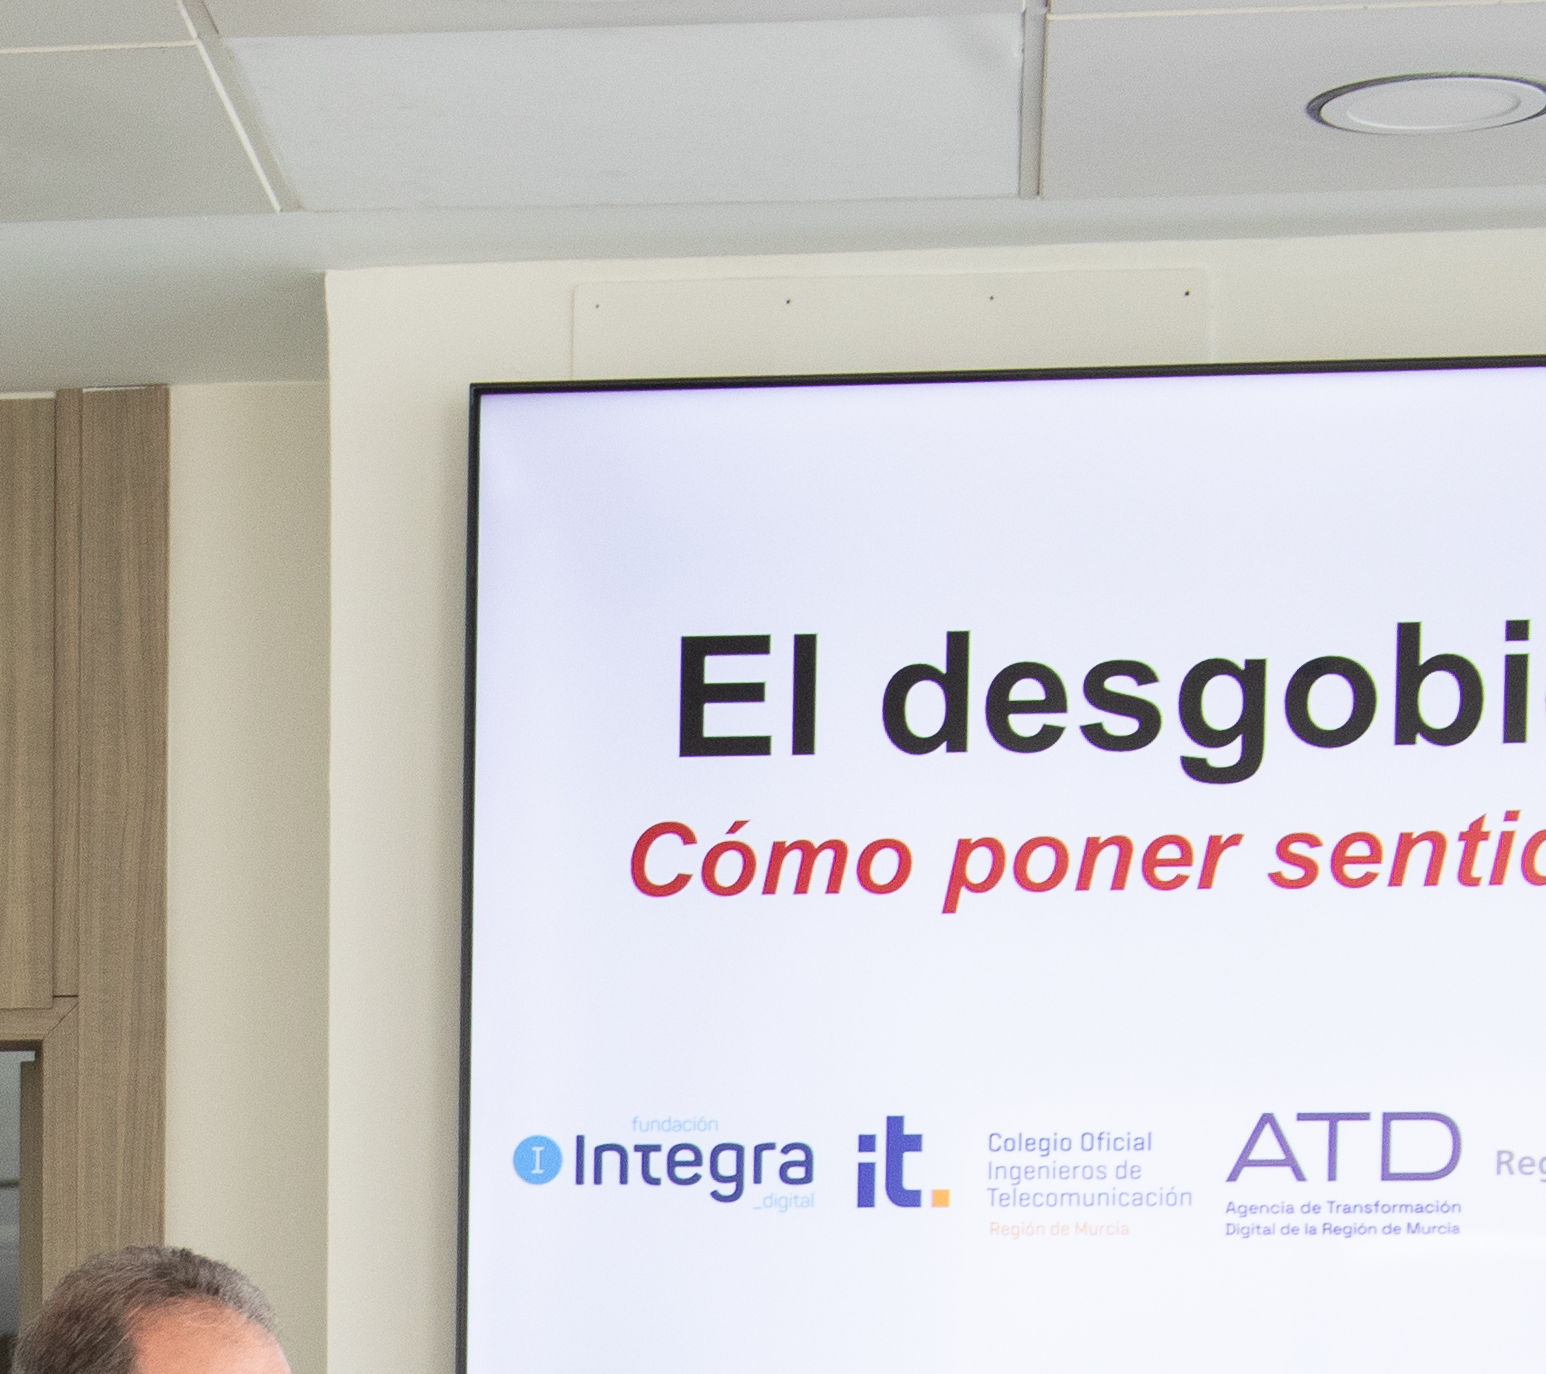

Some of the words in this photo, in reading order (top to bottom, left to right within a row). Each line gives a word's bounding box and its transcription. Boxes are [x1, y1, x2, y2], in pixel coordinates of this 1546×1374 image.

[679, 632, 818, 759] El
[629, 819, 913, 898] Cómo
[941, 832, 1245, 915] poner
[632, 1115, 719, 1134] fundación
[988, 1131, 1073, 1157] Colegio
[1080, 1131, 1154, 1153] Oficial
[1225, 1112, 1464, 1183] ATD
[575, 1134, 815, 1204] Integra
[987, 1160, 1108, 1186] Ingenieros
[1114, 1159, 1143, 1181] de
[986, 1186, 1194, 1208] Telecomunicación
[1225, 1201, 1296, 1219] Agencia
[1300, 1200, 1323, 1216] de
[1326, 1199, 1463, 1216] Transformación
[989, 1220, 1047, 1241] Región
[1050, 1221, 1071, 1237] de
[1075, 1221, 1131, 1237] Murcia
[1225, 1222, 1277, 1240] Digital
[1280, 1222, 1301, 1236] de
[1304, 1222, 1319, 1236] la
[1321, 1221, 1379, 1240] Región
[1382, 1222, 1403, 1237] de
[1407, 1221, 1462, 1236] Murcia
